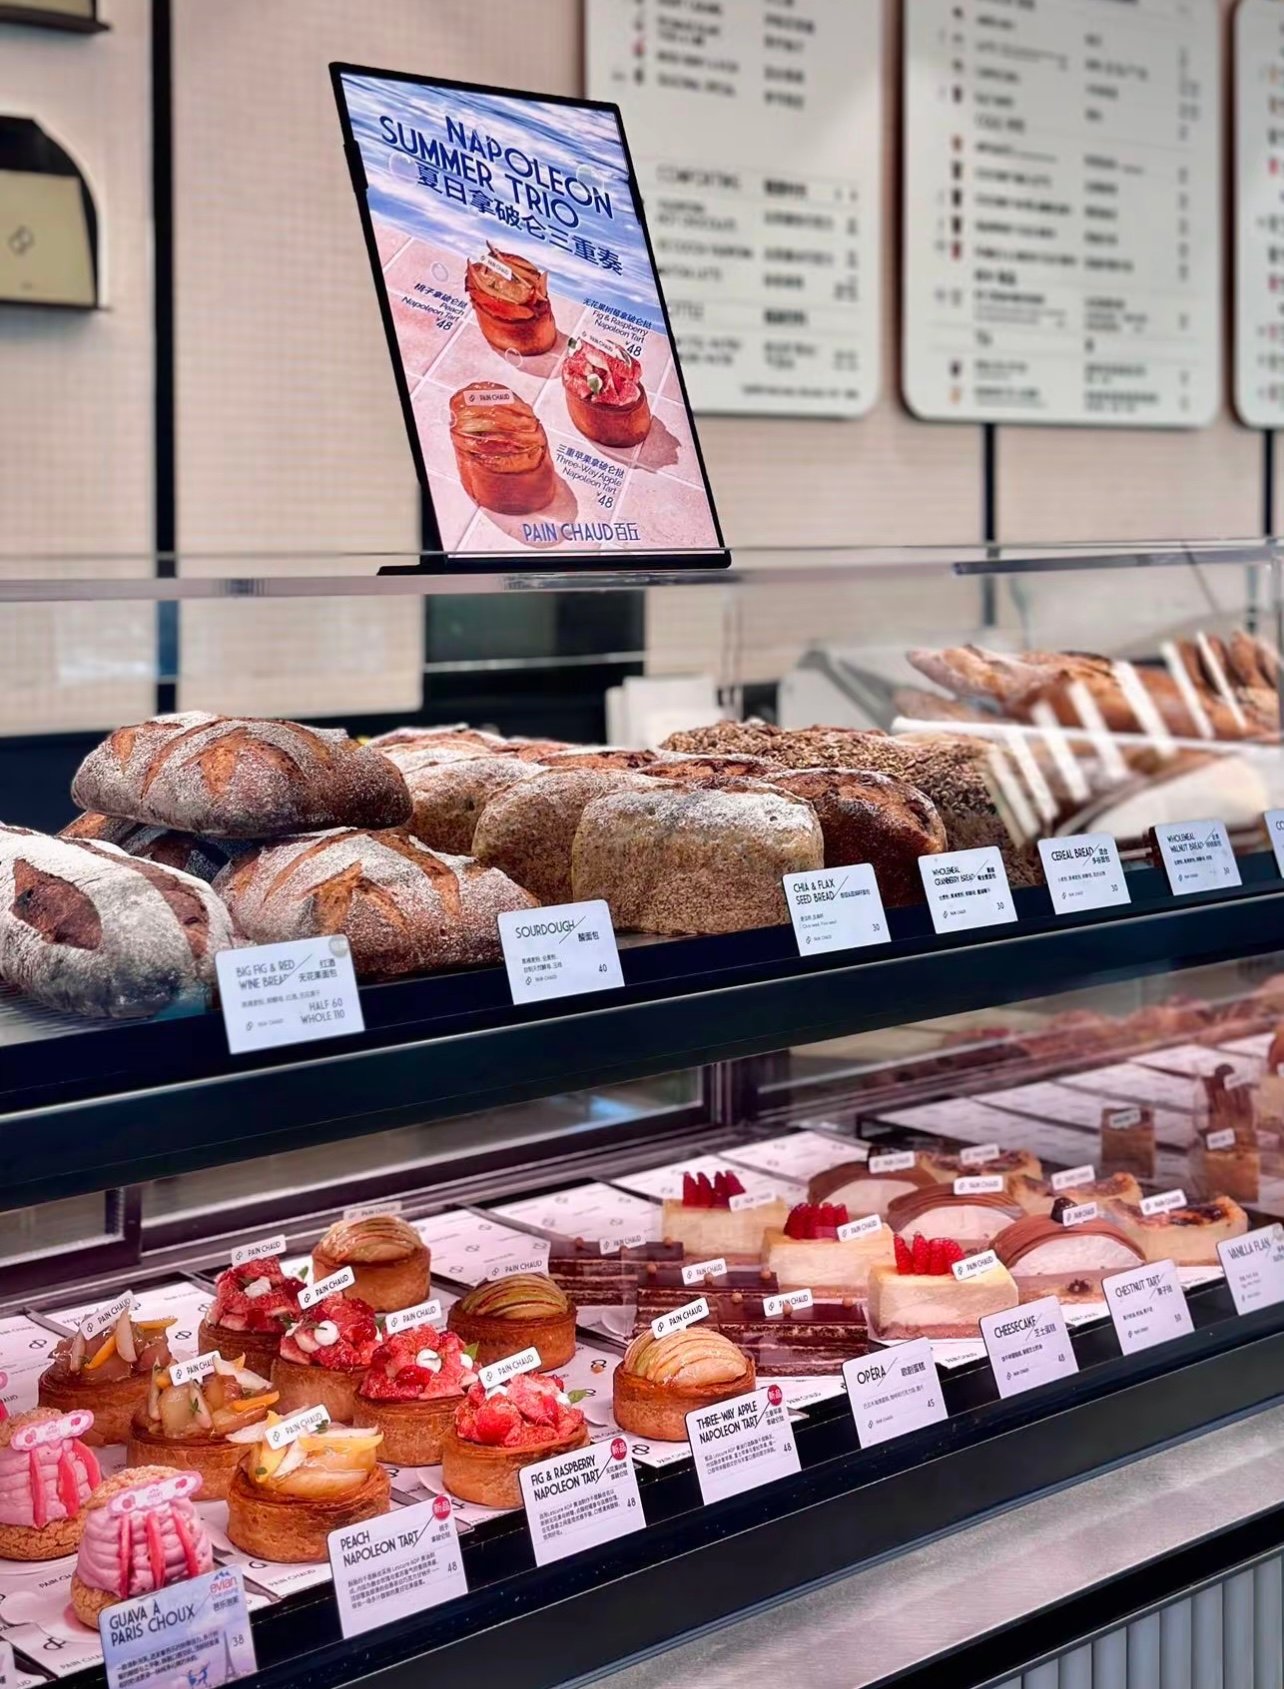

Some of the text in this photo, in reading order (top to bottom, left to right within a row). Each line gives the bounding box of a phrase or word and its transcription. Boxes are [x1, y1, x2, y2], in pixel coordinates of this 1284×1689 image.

[379, 115, 495, 192] SUMMER
[505, 173, 579, 229] TRIO
[445, 115, 614, 219] NAPOLEON
[415, 161, 623, 276] 夏日拿破仑三重奏
[401, 296, 460, 322] Napoleon Tart
[439, 302, 465, 316] Peach
[592, 310, 604, 321] Fig
[610, 316, 649, 337] Raspberry
[594, 319, 645, 344] Napoleon Tart
[556, 453, 622, 487] Three-Way Apple
[563, 467, 617, 495] Napoleon Tart
[522, 522, 558, 541] PAIN
[560, 522, 614, 541] CHAUD
[1051, 850, 1074, 861] CEREAL
[1074, 846, 1094, 858] BREAD
[793, 879, 835, 893] CHIA & FLAX
[795, 891, 835, 905] SEED BREAD
[515, 919, 575, 939] SOURDOUGH
[236, 959, 296, 978] BIG FIG & RED
[238, 977, 262, 990] WINE
[309, 999, 329, 1011] HALF
[331, 997, 343, 1008] 60
[300, 1009, 345, 1025] WHOLE 110
[248, 1241, 281, 1257] PAIN CHAUD
[1227, 1242, 1254, 1260] VANILLA
[505, 1260, 543, 1273] PAIN CHAUD
[966, 1256, 994, 1271] PAIN CHAUD
[315, 1274, 350, 1296] PAIN CHAUD
[1115, 1274, 1161, 1298] CHESTNUT TART
[790, 1294, 809, 1305] CHAUD
[97, 1298, 131, 1325] PAIN CHAUD
[402, 1305, 437, 1323] PAIN CHAUD
[668, 1305, 703, 1326] PAIN CHAUD
[994, 1315, 1036, 1338] CHEESECAKE
[186, 1364, 200, 1375] PAIN
[497, 1354, 534, 1375] PAIN CHAUD
[856, 1364, 887, 1385] OPÉRA
[285, 1412, 323, 1434] PAIN CHAUD
[696, 1400, 758, 1430] THREE-WAY APPLE
[699, 1415, 759, 1444] NAPOLEON TART
[783, 1442, 792, 1452] 48
[530, 1455, 596, 1486] FIG & RASPBERRY
[533, 1468, 600, 1501] NAPOLEON TART
[627, 1497, 636, 1508] 48
[340, 1530, 370, 1551] PEACH
[343, 1530, 419, 1567] NAPOLEON TART
[447, 1561, 457, 1573] 48
[210, 1576, 238, 1594] evian
[109, 1604, 148, 1630] GUAVA
[111, 1603, 196, 1647] PARIS CHOUX
[232, 1634, 245, 1647] 38
